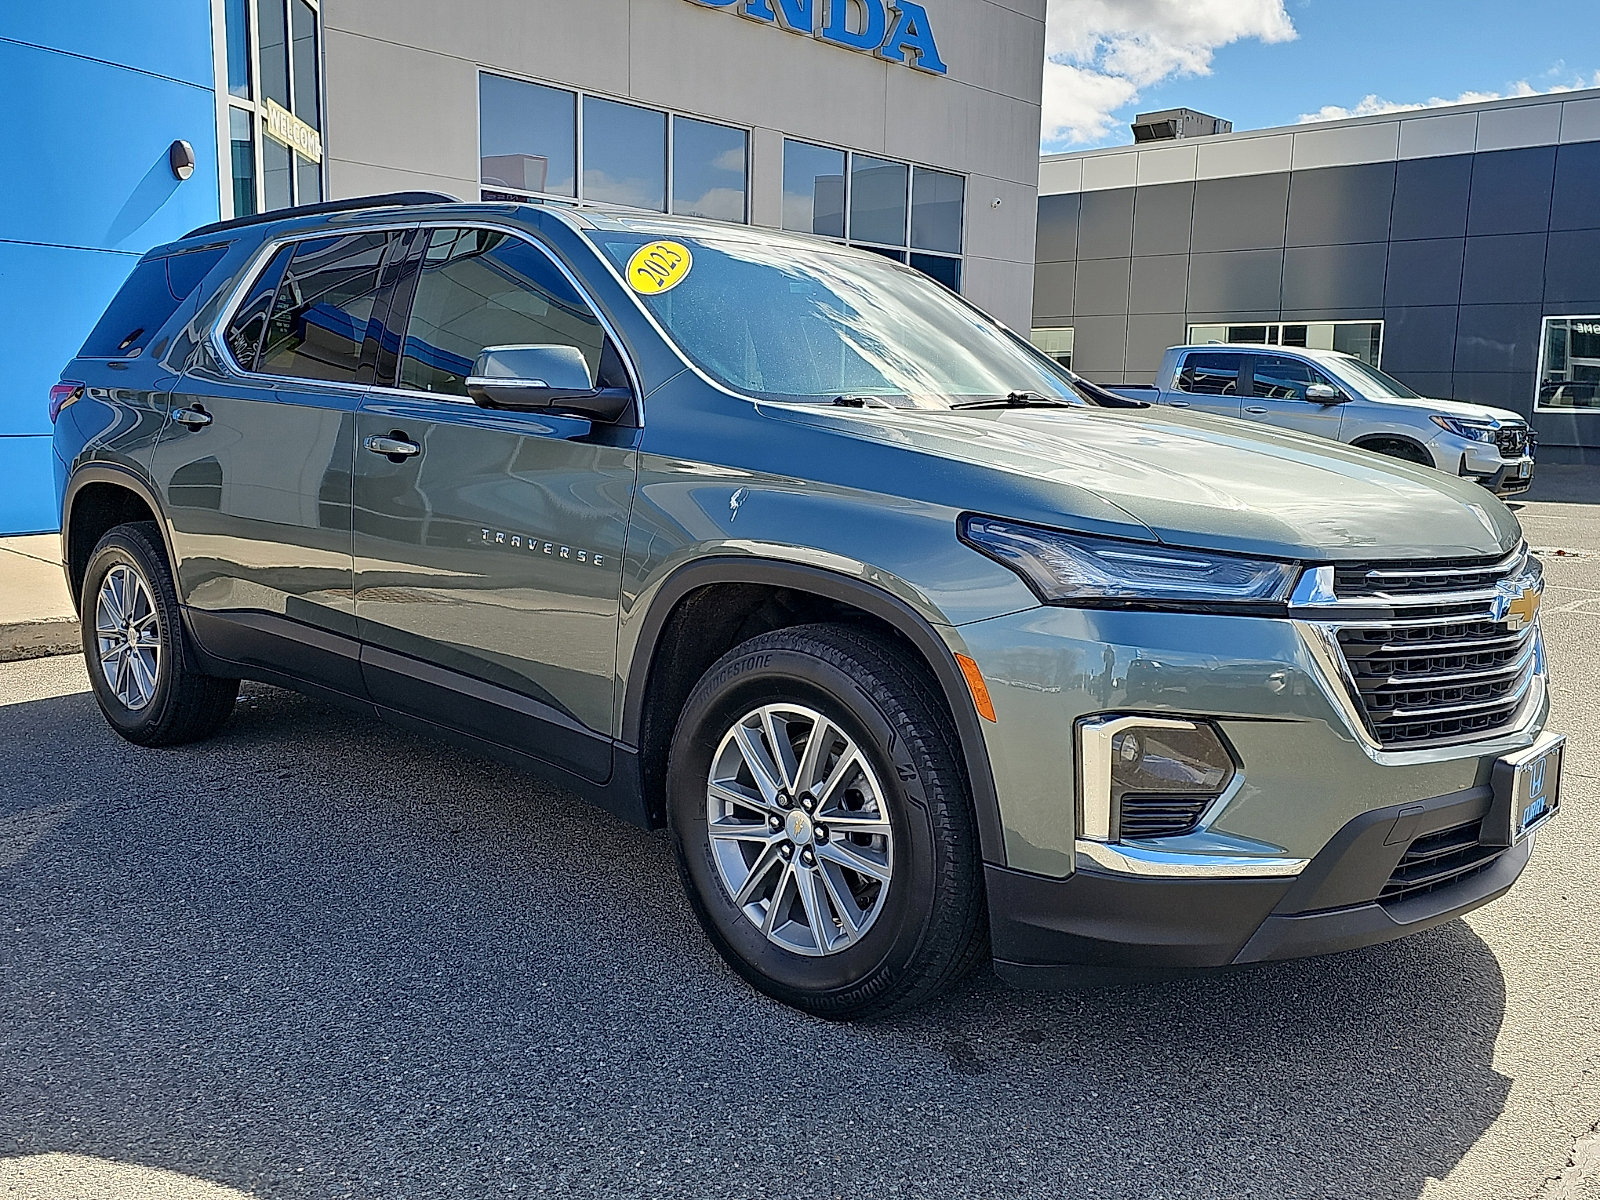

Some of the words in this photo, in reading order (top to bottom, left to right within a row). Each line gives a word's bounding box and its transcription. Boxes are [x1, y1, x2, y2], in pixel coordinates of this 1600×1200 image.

[697, 0, 947, 75] NDA
[268, 105, 320, 158] WELCOME
[637, 245, 682, 288] 2023
[481, 528, 604, 567] TRAVERSE
[698, 653, 773, 705] BRIDGESTONE
